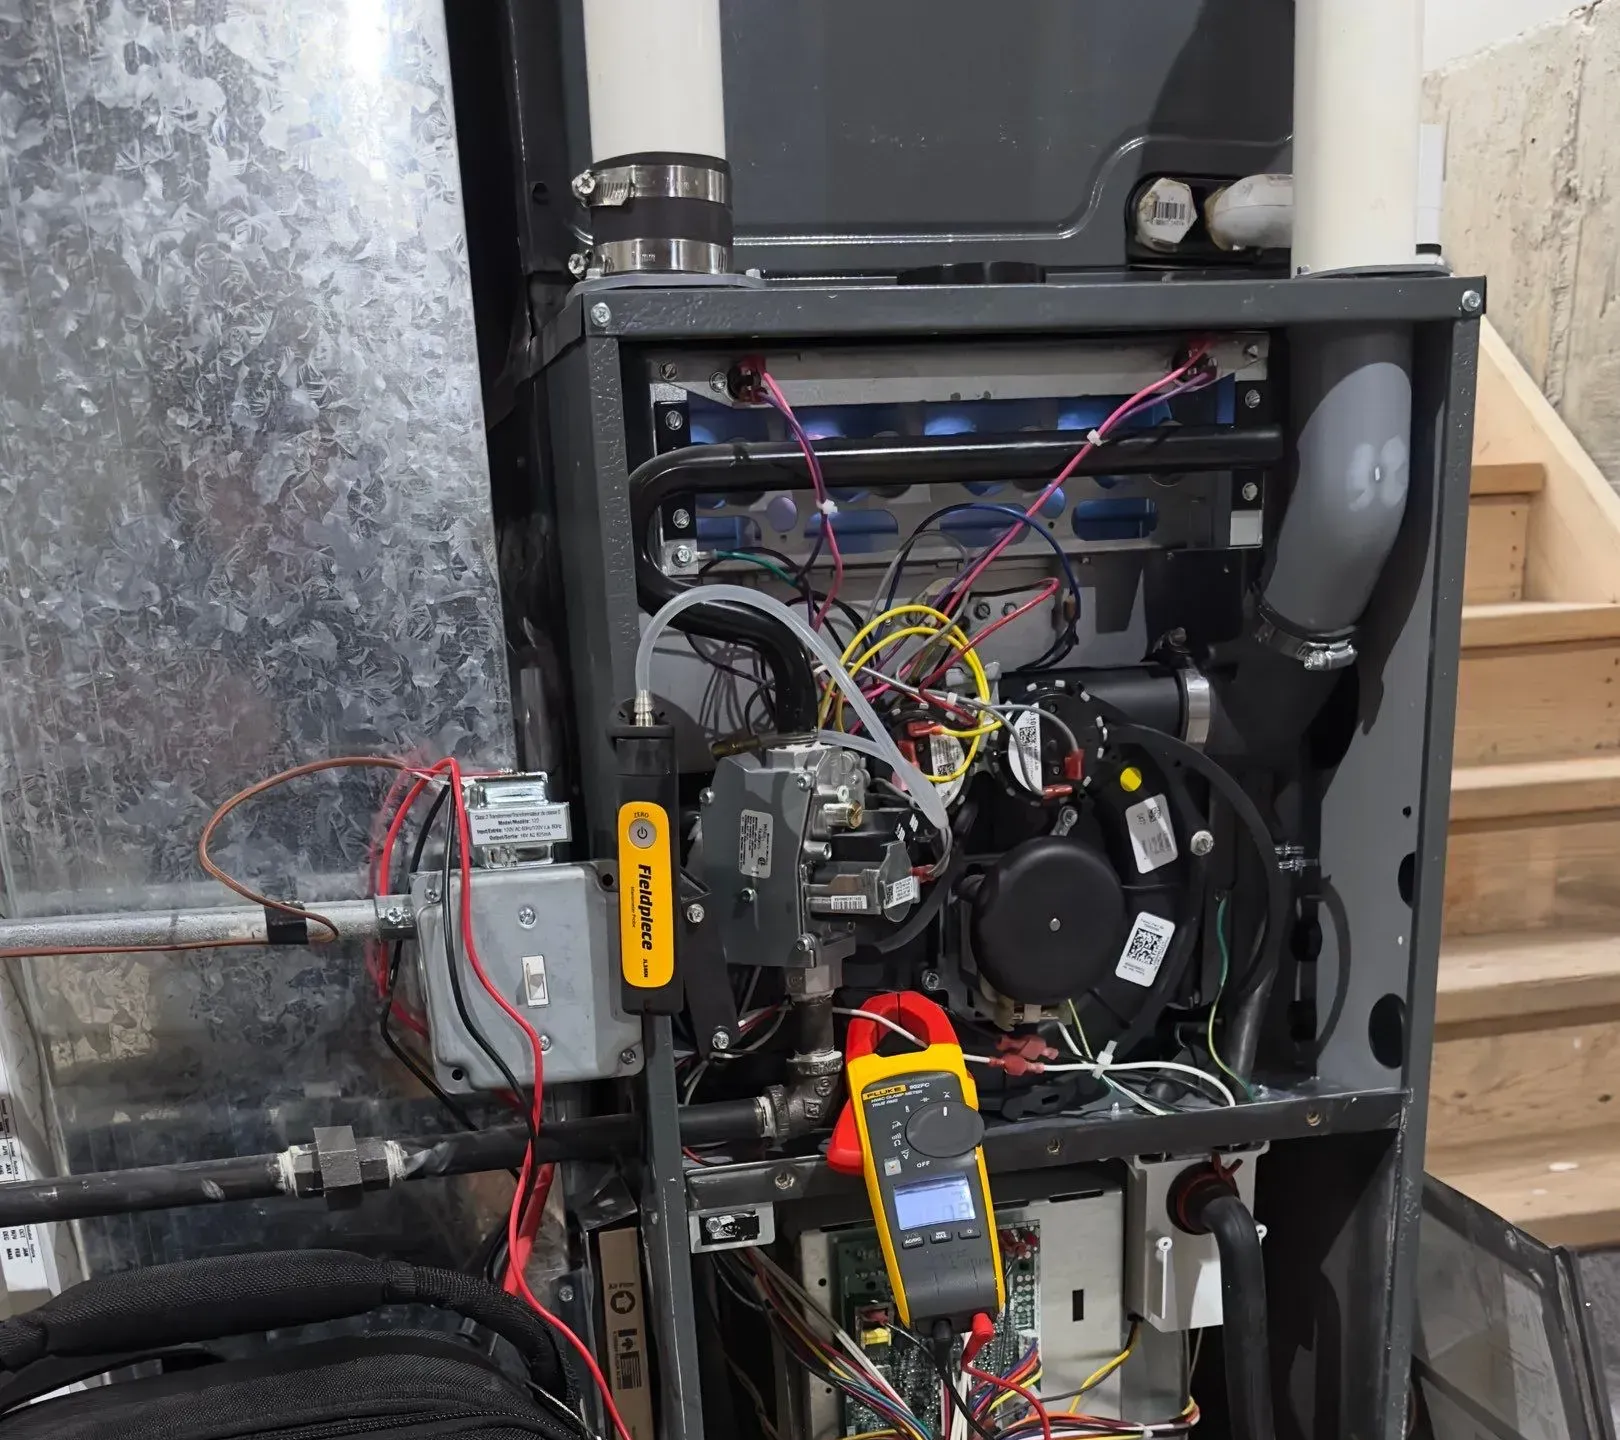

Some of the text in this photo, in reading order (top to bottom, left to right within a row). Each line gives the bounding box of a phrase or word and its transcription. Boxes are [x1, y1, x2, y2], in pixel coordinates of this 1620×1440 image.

[633, 811, 649, 819] ZERO
[638, 864, 653, 951] Fieldpiece
[867, 1086, 902, 1098] FLUKE
[916, 1160, 931, 1168] OFF
[2, 1231, 10, 1241] DEC
